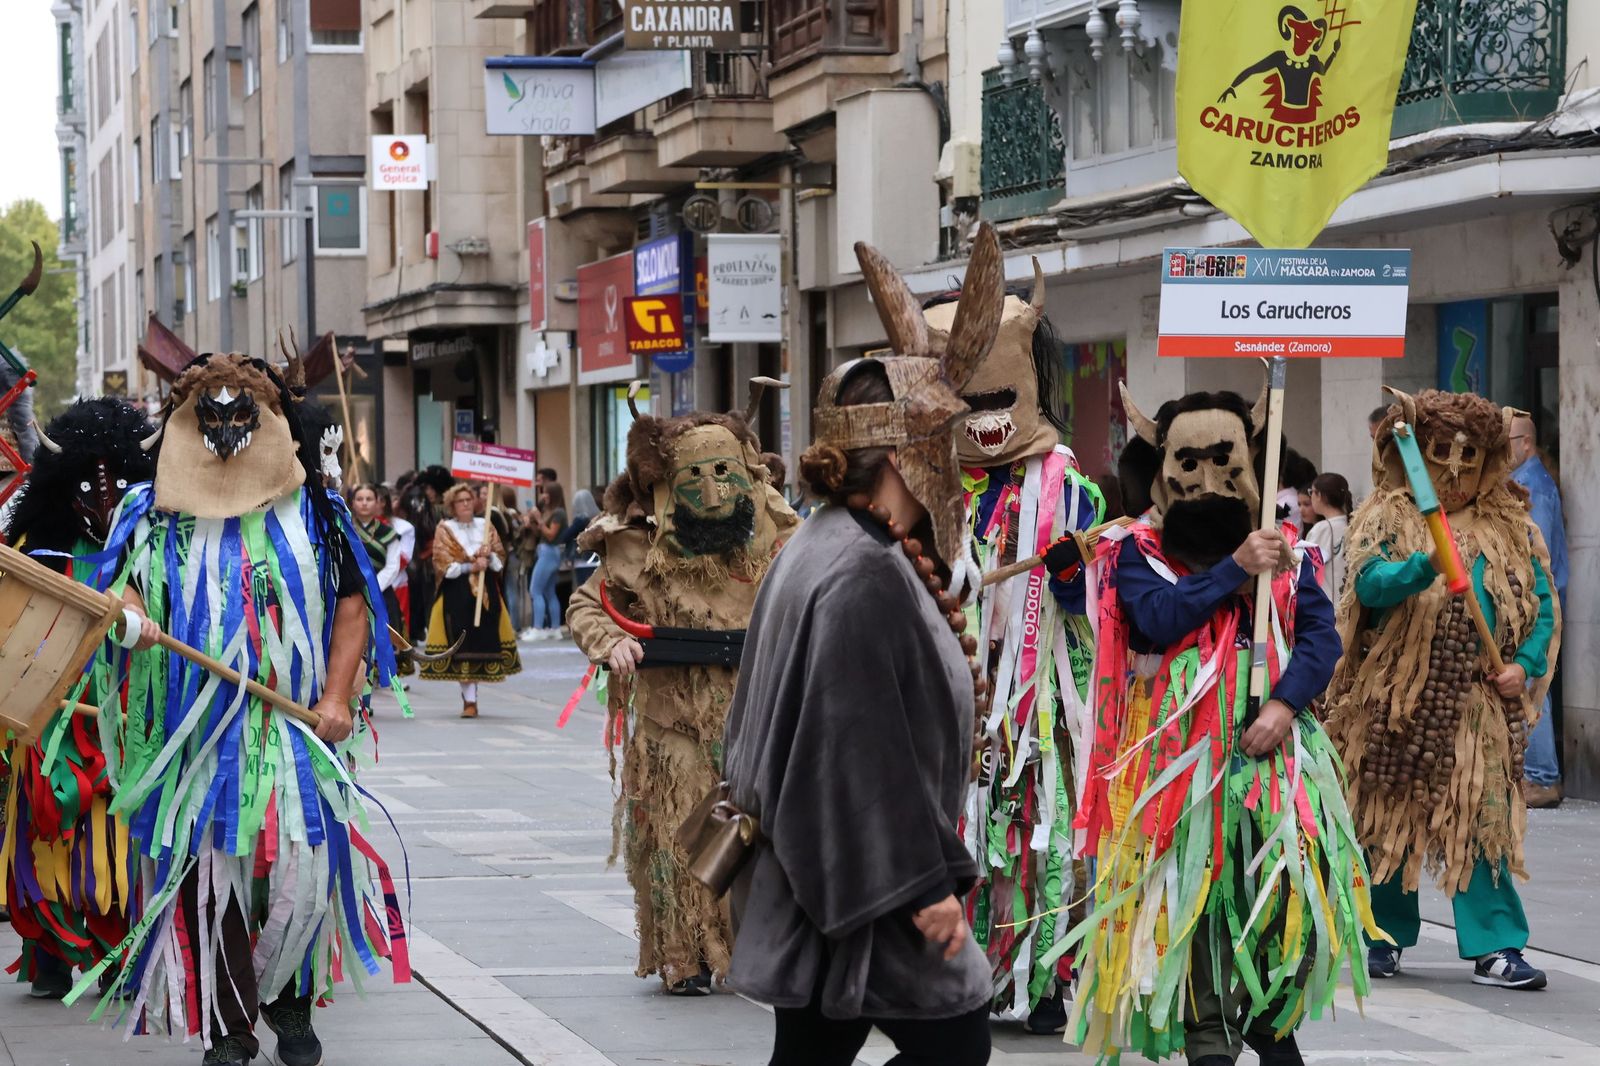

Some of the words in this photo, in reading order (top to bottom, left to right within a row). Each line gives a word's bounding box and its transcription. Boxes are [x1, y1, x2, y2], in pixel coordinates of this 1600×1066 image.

[631, 6, 734, 32] CAXANDRA
[667, 35, 714, 48] PLANTA
[1200, 106, 1361, 148] CARUCHEROS
[1250, 151, 1323, 169] ZAMORA
[380, 164, 421, 173] General
[1252, 257, 1280, 277] XIV
[1281, 257, 1309, 266] FESTIVAL
[1319, 258, 1328, 266] LA
[1330, 269, 1340, 277] EN
[1340, 268, 1376, 278] ZAMORA
[1221, 300, 1250, 319] Los
[1256, 300, 1352, 320] Carucheros
[630, 338, 682, 350] TABACOS
[1234, 341, 1285, 353] Sesnández
[1288, 341, 1332, 354] (Zamora)
